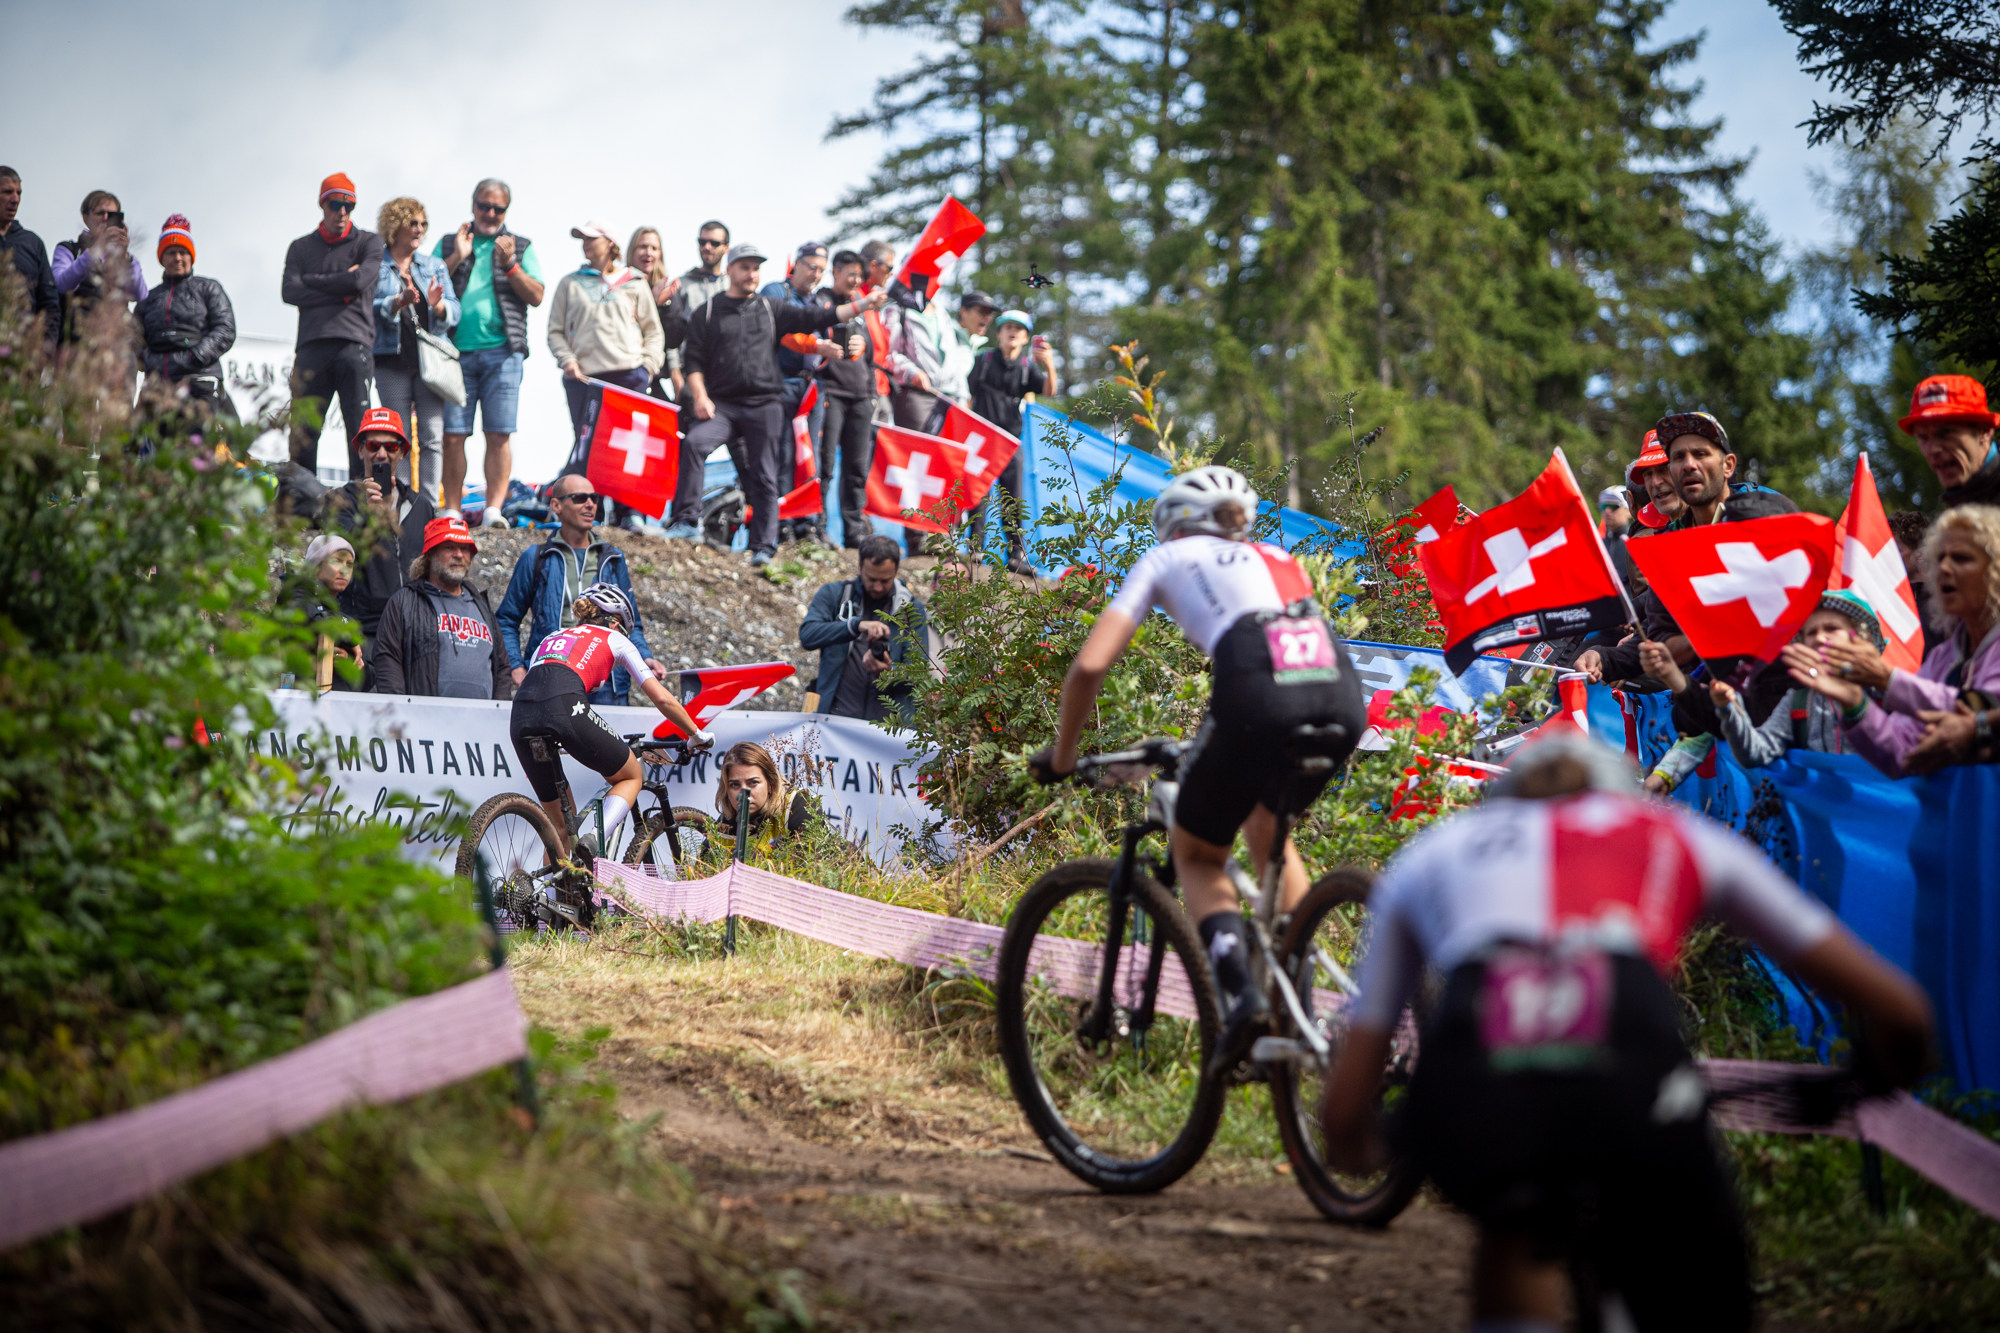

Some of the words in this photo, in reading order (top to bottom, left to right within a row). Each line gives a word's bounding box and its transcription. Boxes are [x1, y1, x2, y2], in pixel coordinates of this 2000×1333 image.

[545, 638, 567, 652] 18
[580, 641, 599, 664] TUDOR
[1279, 631, 1321, 665] 27
[335, 735, 512, 778] MONTANA
